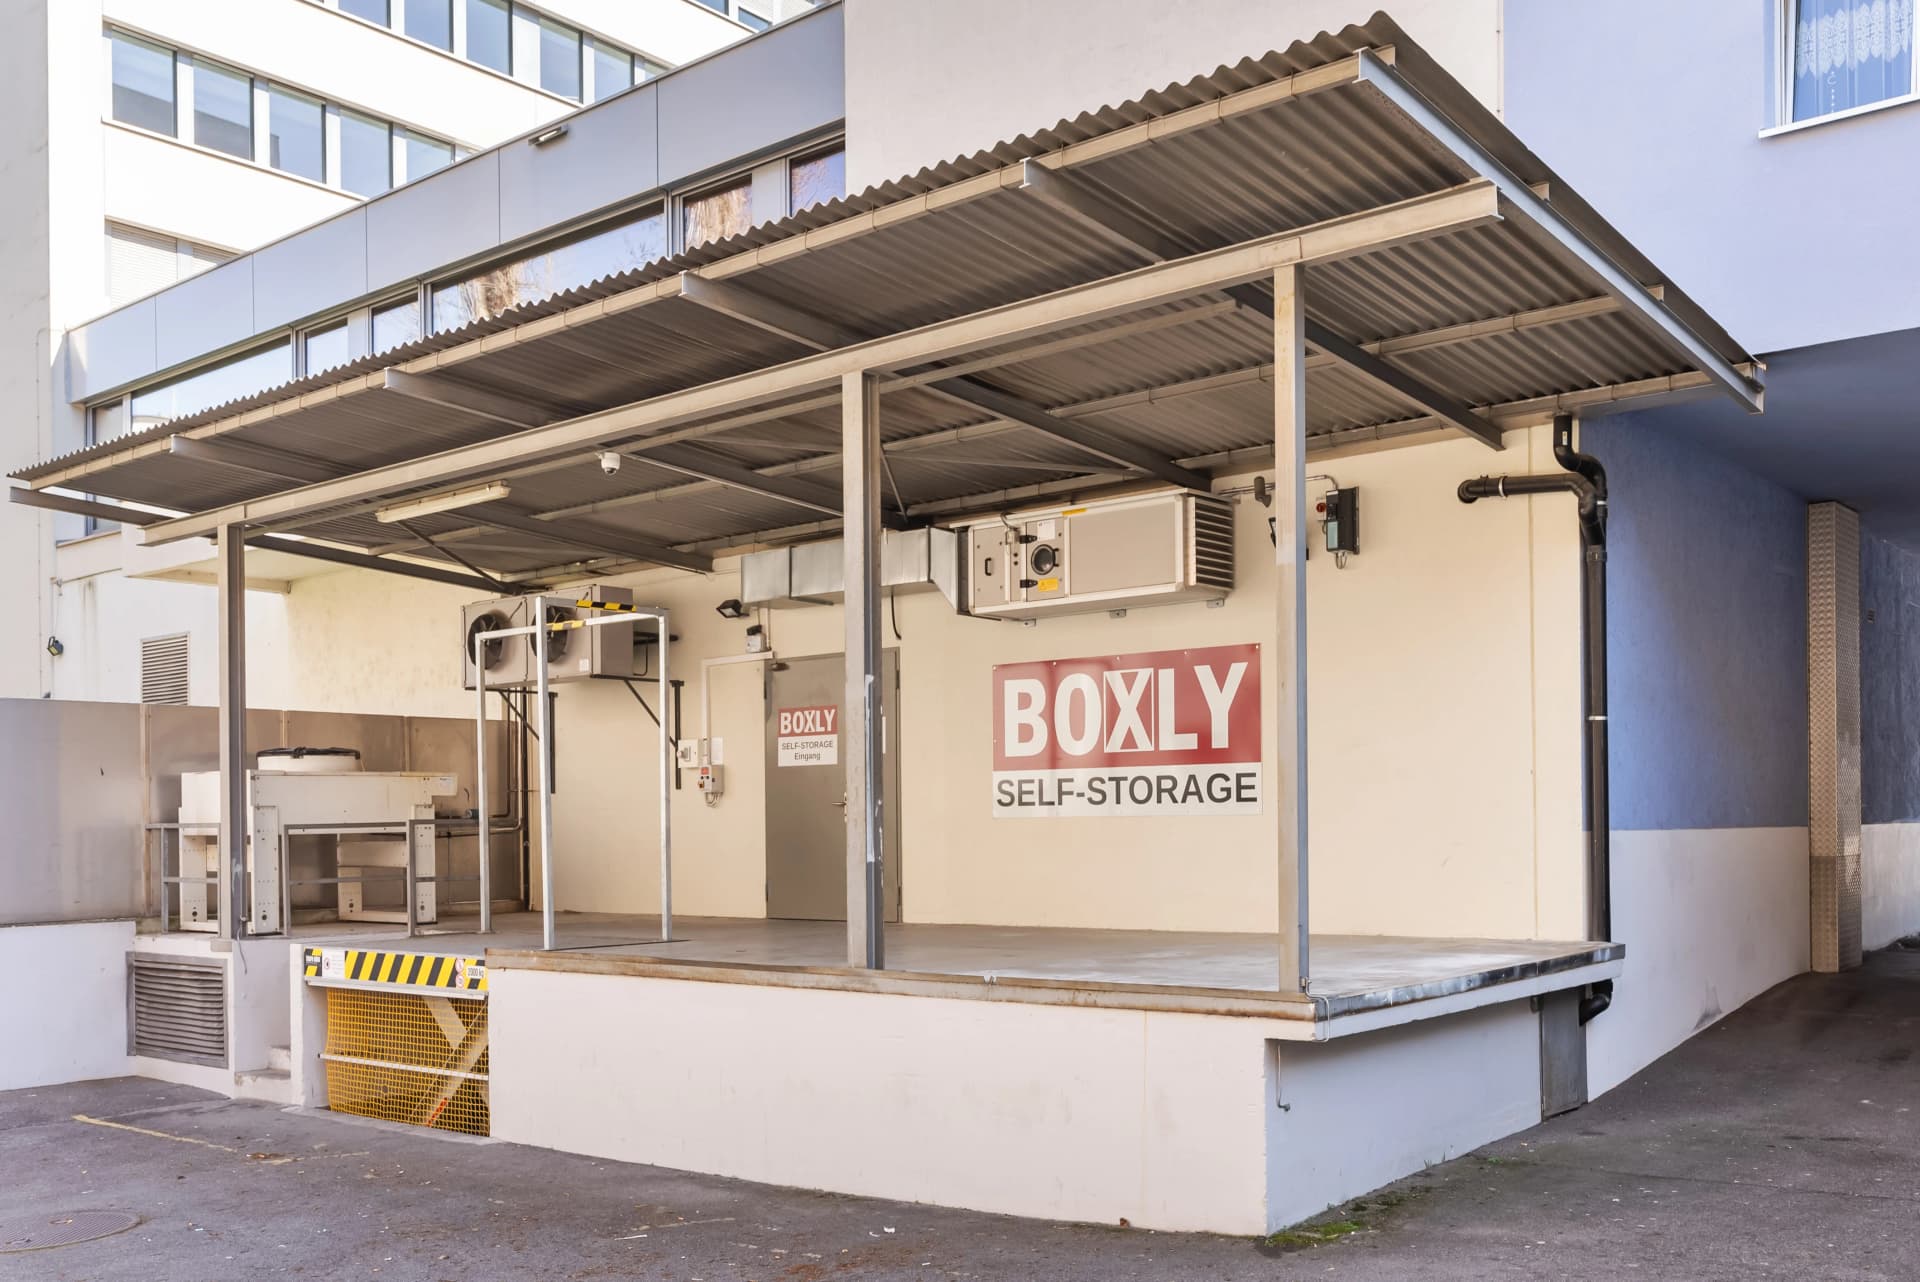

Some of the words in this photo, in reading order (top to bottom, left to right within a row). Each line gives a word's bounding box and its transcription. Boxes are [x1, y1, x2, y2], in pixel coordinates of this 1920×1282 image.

[780, 709, 836, 735] BOXLY
[1003, 662, 1248, 757] BOXLY
[781, 740, 833, 751] SELF-STORAGE
[794, 752, 821, 762] Eingang
[996, 772, 1258, 807] SELF-STORAGE
